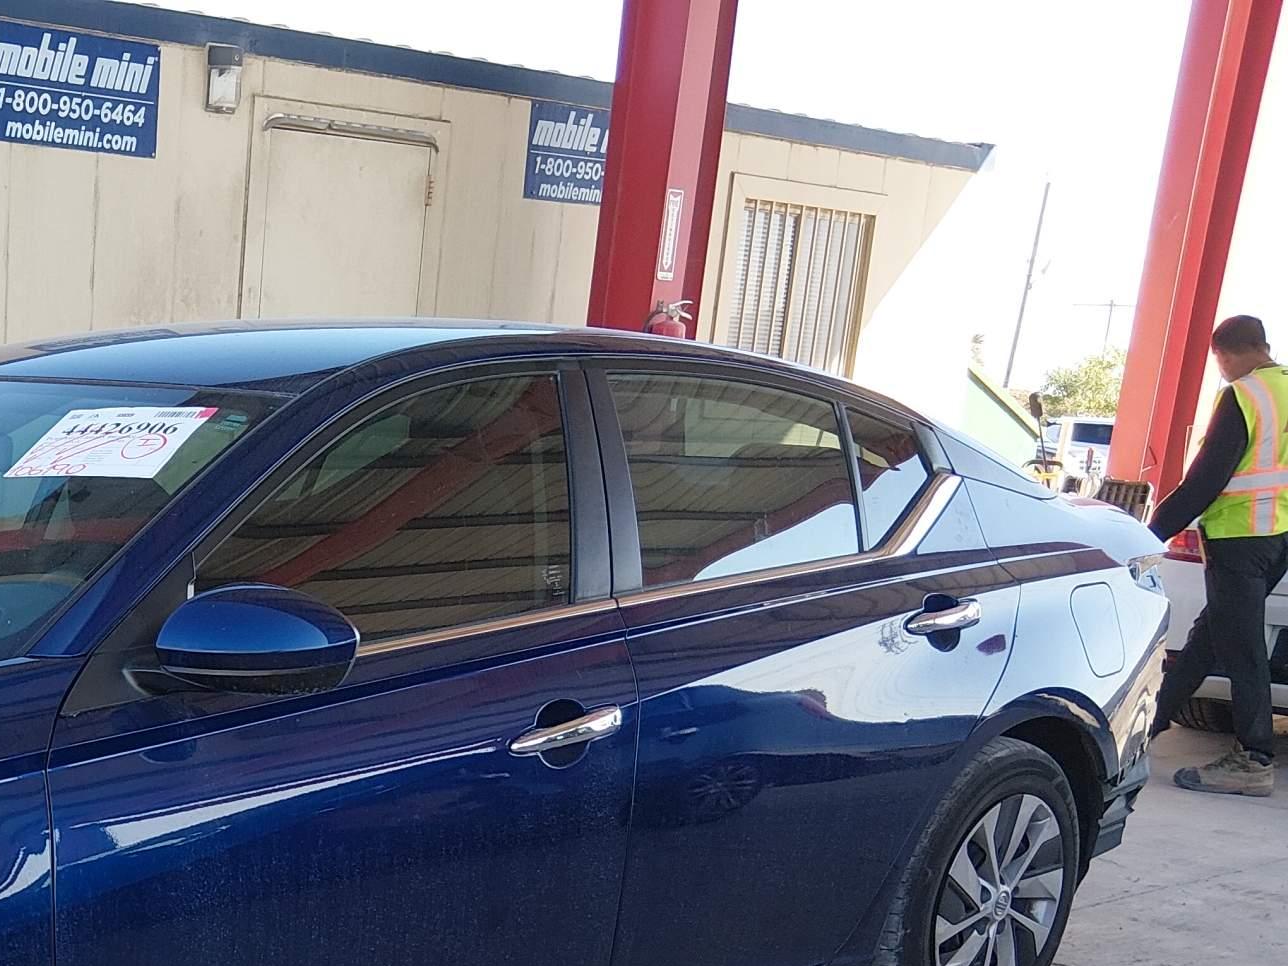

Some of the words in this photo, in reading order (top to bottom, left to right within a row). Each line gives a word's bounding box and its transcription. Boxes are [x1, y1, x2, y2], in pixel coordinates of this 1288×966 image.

[90, 52, 155, 94] mini
[5, 119, 137, 152] mobilemini.com
[532, 111, 601, 153] mobile
[62, 422, 183, 436] 44426906
